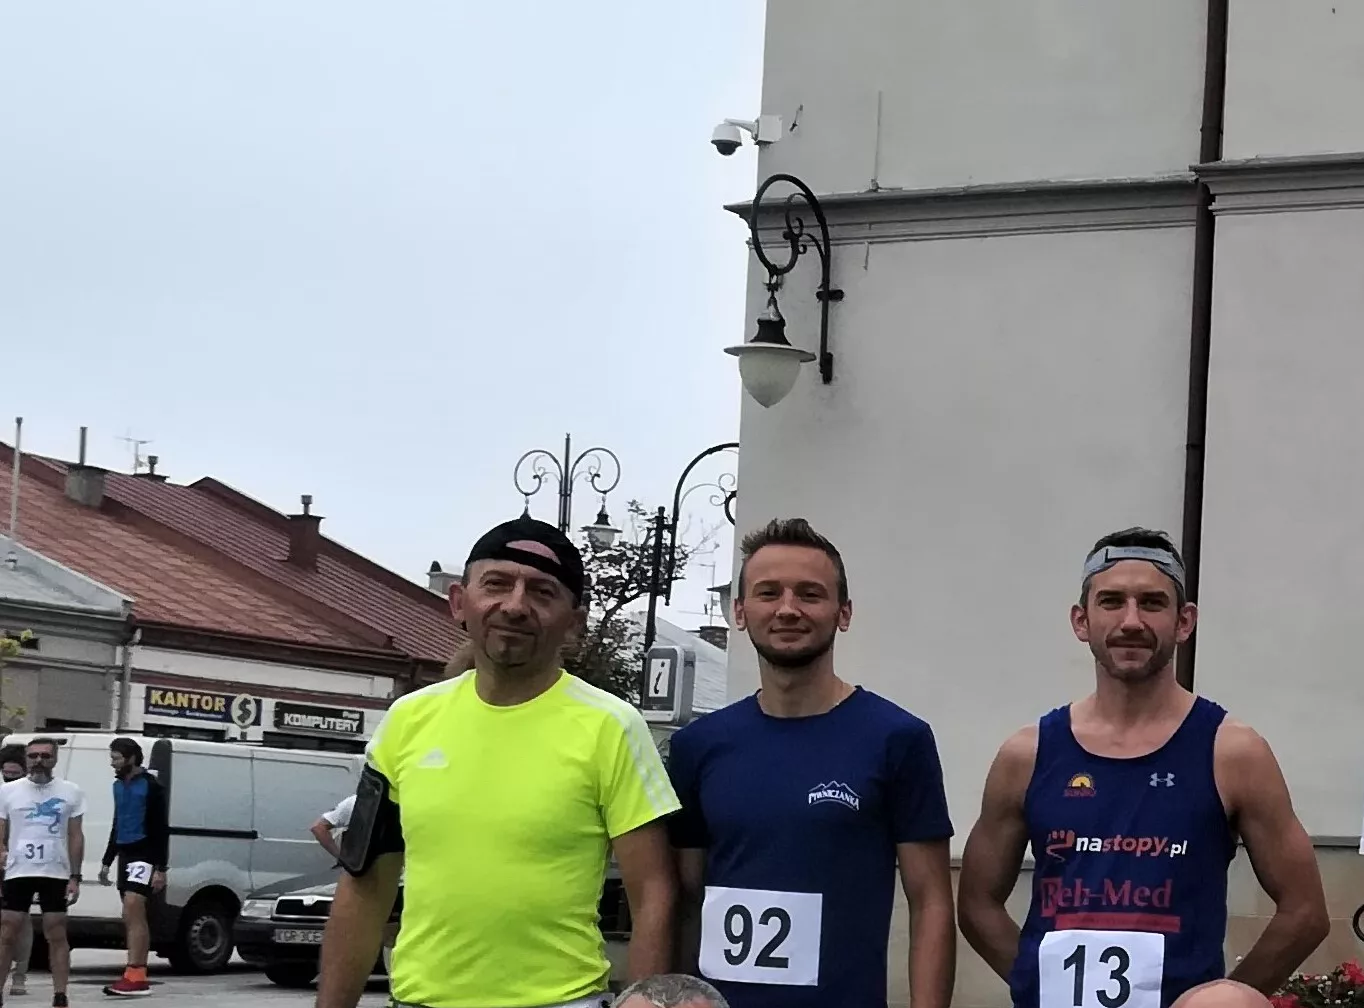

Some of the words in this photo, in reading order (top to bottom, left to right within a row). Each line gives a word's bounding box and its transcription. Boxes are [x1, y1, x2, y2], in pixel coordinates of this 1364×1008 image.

[150, 689, 226, 712] KANTOR
[283, 713, 360, 732] KOMPUTERY
[25, 844, 44, 859] 31
[1076, 834, 1188, 857] nastopy.pl
[723, 904, 791, 969] 92
[1063, 944, 1131, 1008] 13
